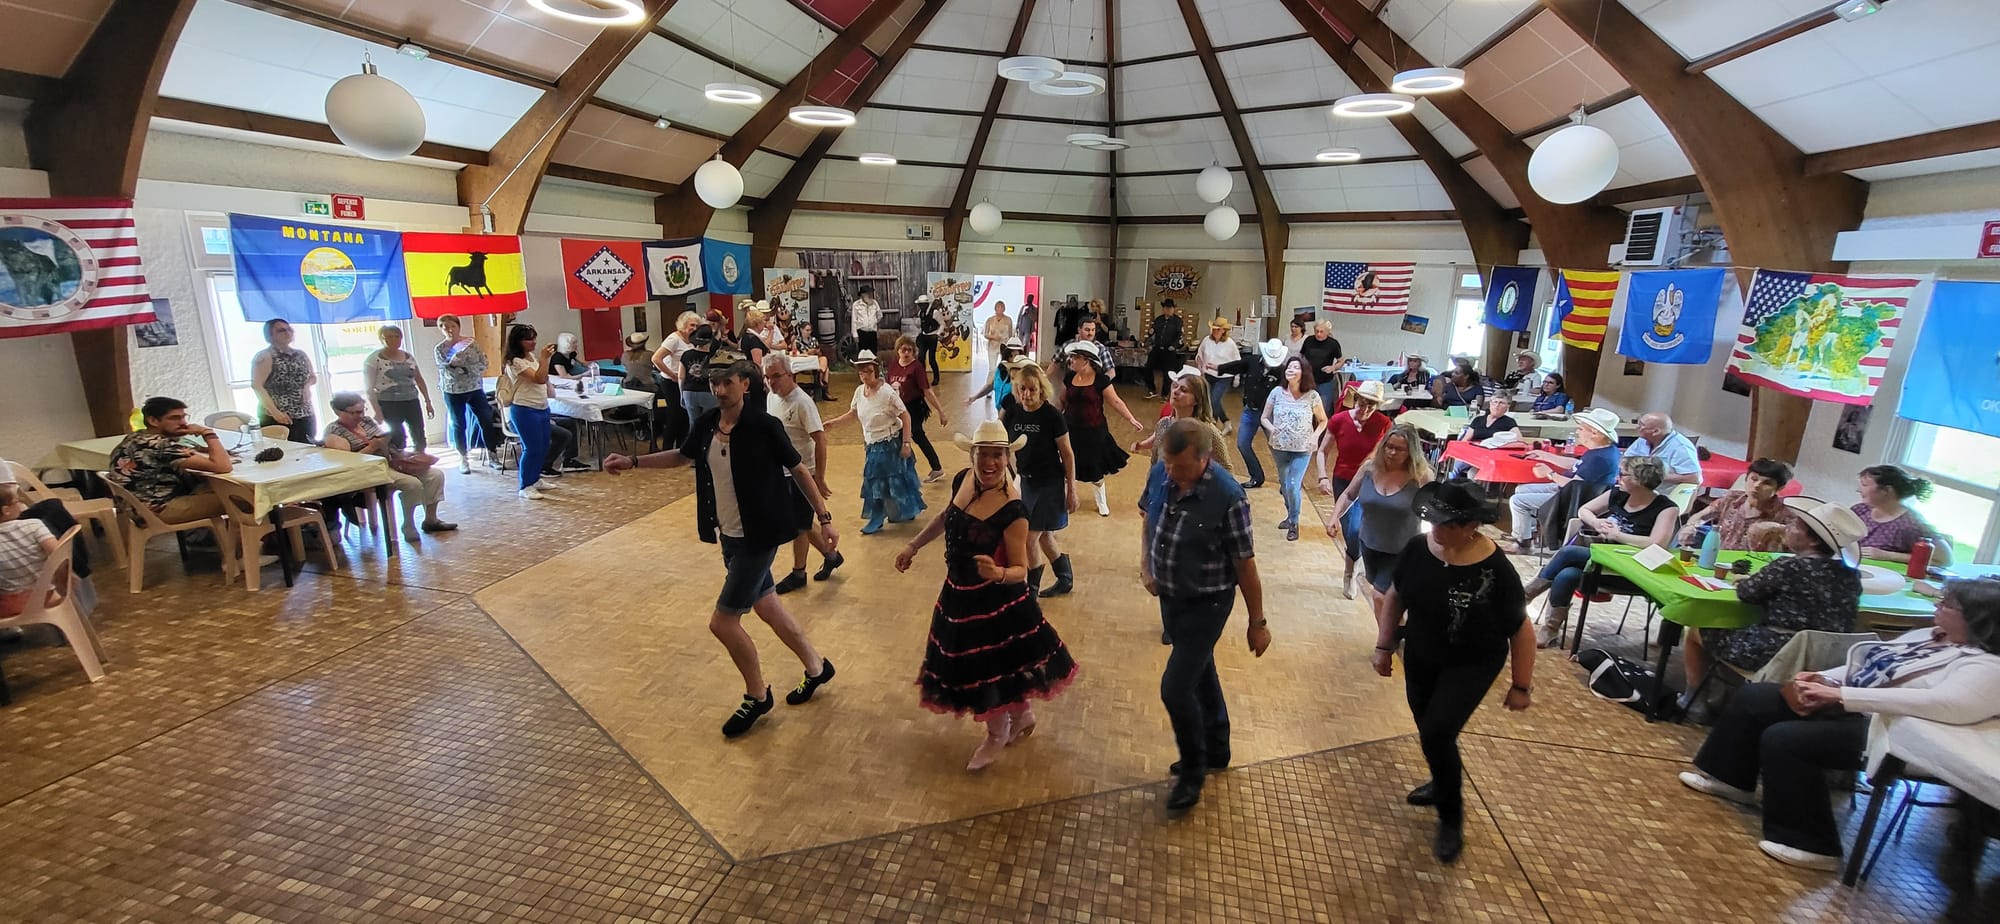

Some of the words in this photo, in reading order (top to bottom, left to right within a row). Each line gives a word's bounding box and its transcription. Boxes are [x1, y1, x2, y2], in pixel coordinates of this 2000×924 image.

[282, 226, 364, 244] MONTANA
[1171, 279, 1182, 288] 66
[1014, 423, 1040, 432] GUESS
